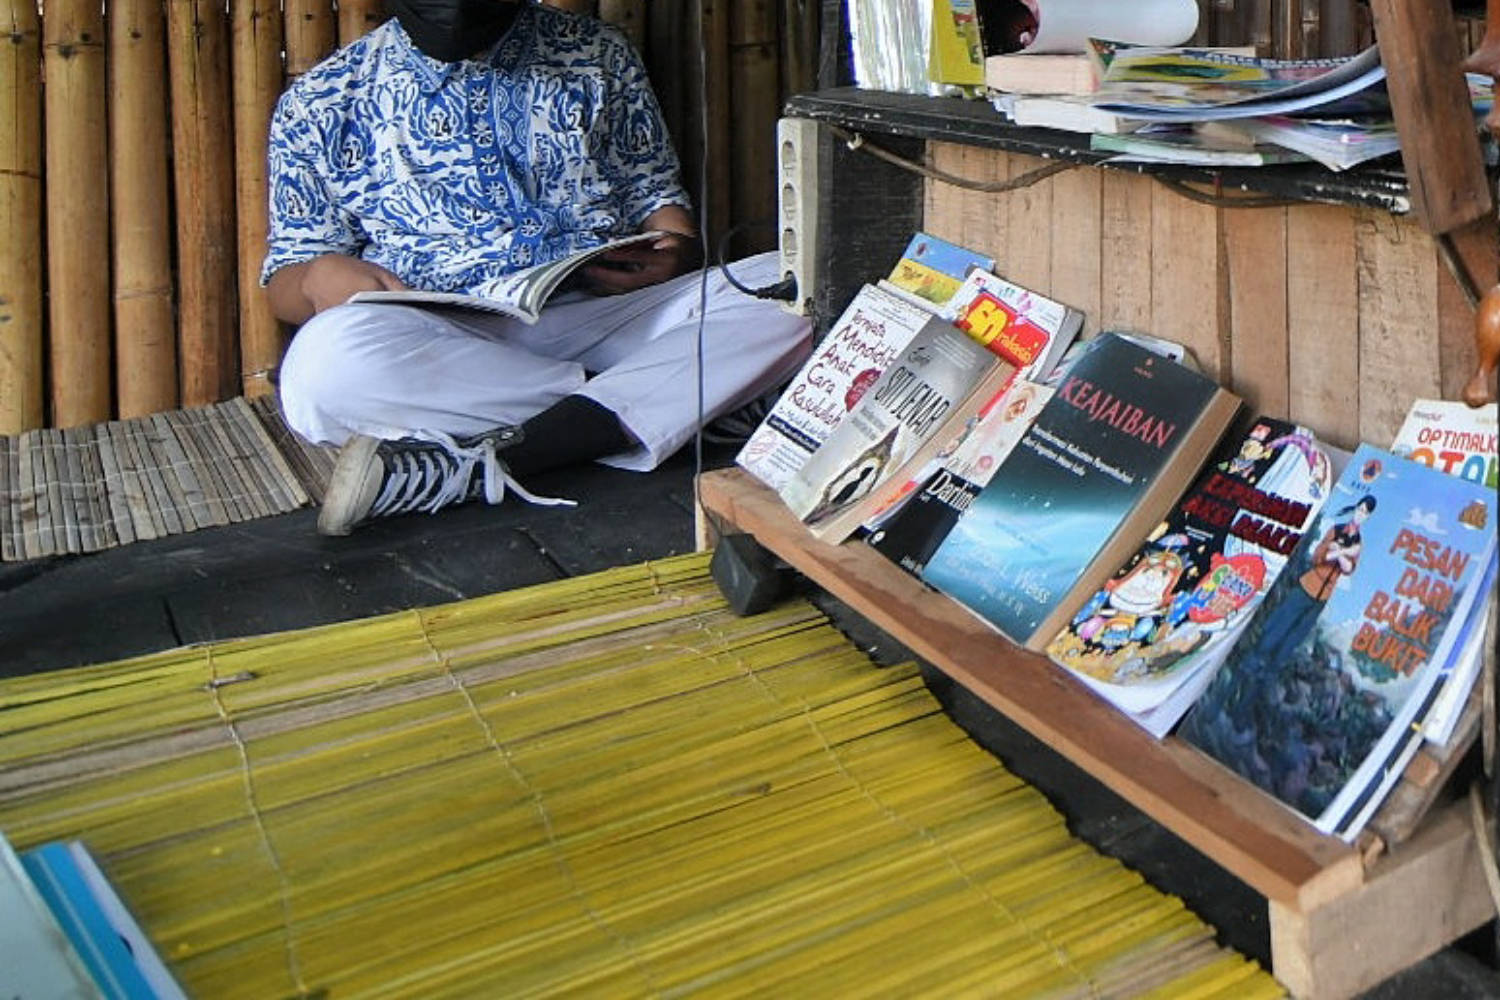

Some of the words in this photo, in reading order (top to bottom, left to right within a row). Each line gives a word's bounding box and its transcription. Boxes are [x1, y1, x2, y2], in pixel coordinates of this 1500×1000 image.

[819, 343, 857, 377] Anak
[834, 324, 896, 368] Mendidik
[806, 362, 836, 396] Cara
[788, 383, 843, 429] Rasulullah
[1057, 376, 1176, 449] KEAJAIBAN
[1417, 426, 1499, 453] OPTIMALK
[1390, 527, 1471, 582] PESAN
[1394, 567, 1456, 613] DARI
[1364, 589, 1441, 645] BALIK
[1351, 620, 1428, 679] BUKIT
